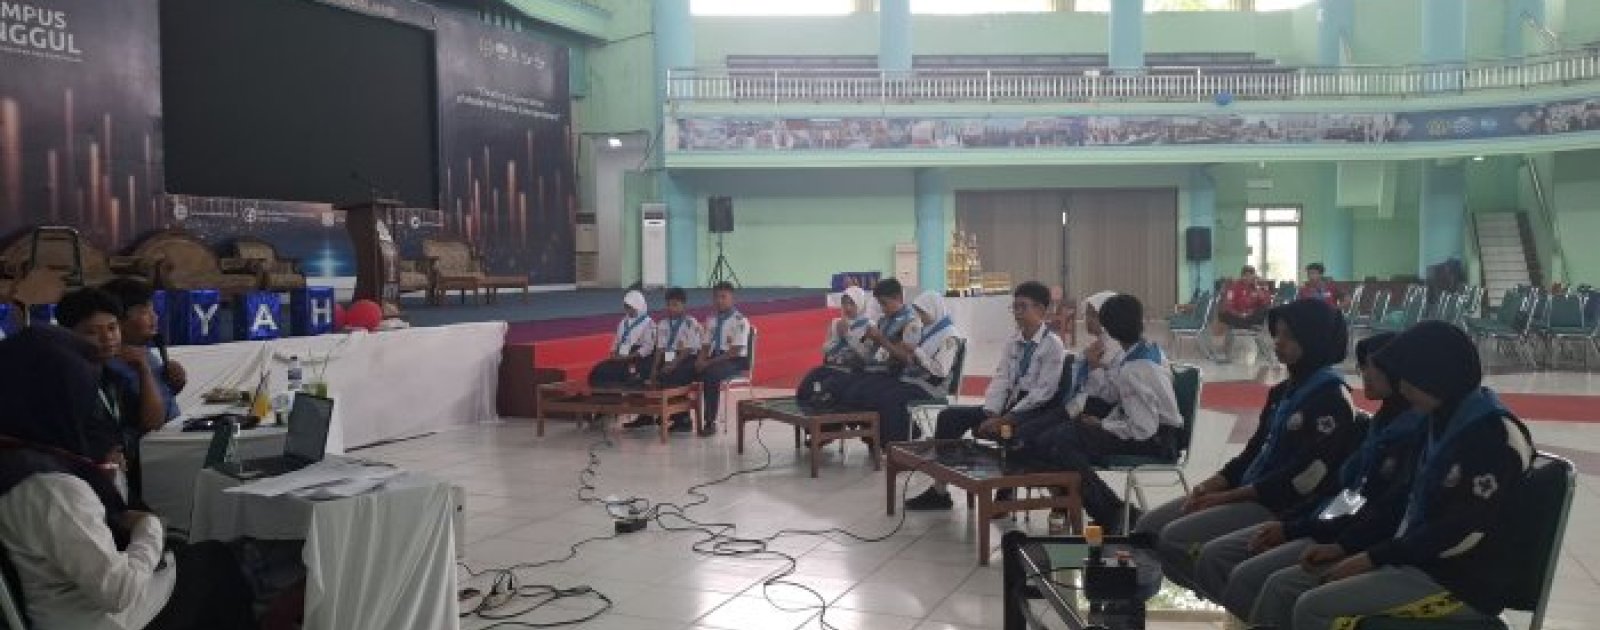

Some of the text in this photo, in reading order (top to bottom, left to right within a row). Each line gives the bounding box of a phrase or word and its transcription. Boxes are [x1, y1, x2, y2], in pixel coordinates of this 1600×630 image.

[193, 298, 333, 336] Y A H
